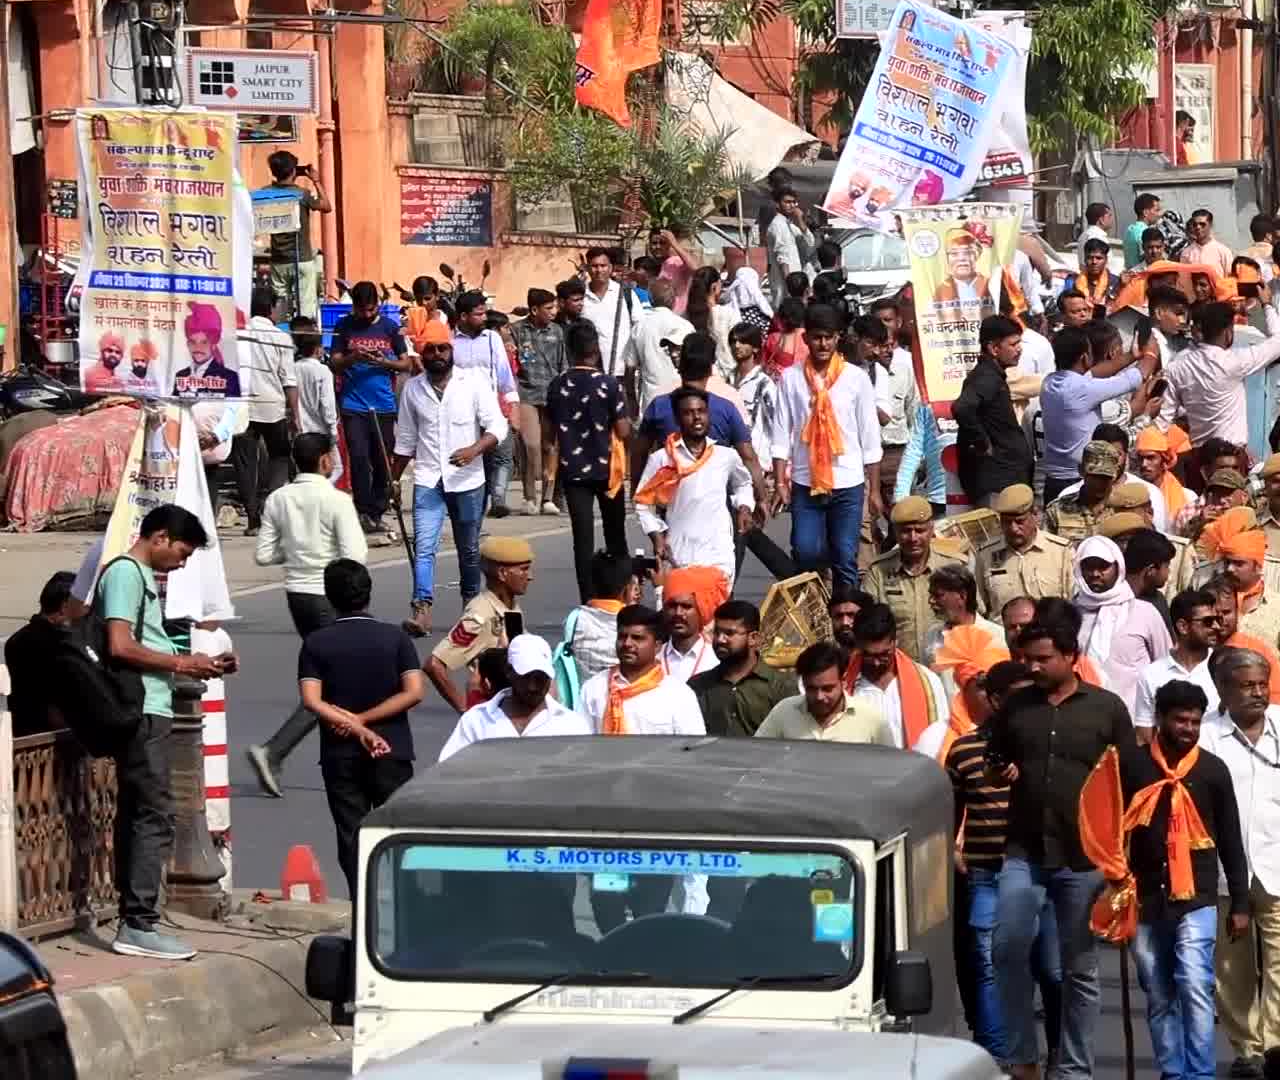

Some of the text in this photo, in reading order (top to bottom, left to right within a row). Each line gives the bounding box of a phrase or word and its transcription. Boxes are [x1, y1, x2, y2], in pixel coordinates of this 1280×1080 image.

[254, 64, 289, 74] JAIPUR
[887, 55, 907, 75] युवा
[241, 78, 303, 89] SMART CITY
[251, 91, 294, 101] LIMITED
[876, 74, 930, 118] विशाल
[99, 176, 121, 198] युवा
[123, 173, 147, 193] शक्ति
[99, 202, 165, 237] विशाल
[107, 246, 170, 268] वाहन
[506, 849, 742, 869] K. S. MOTORS PVT. LTD.
